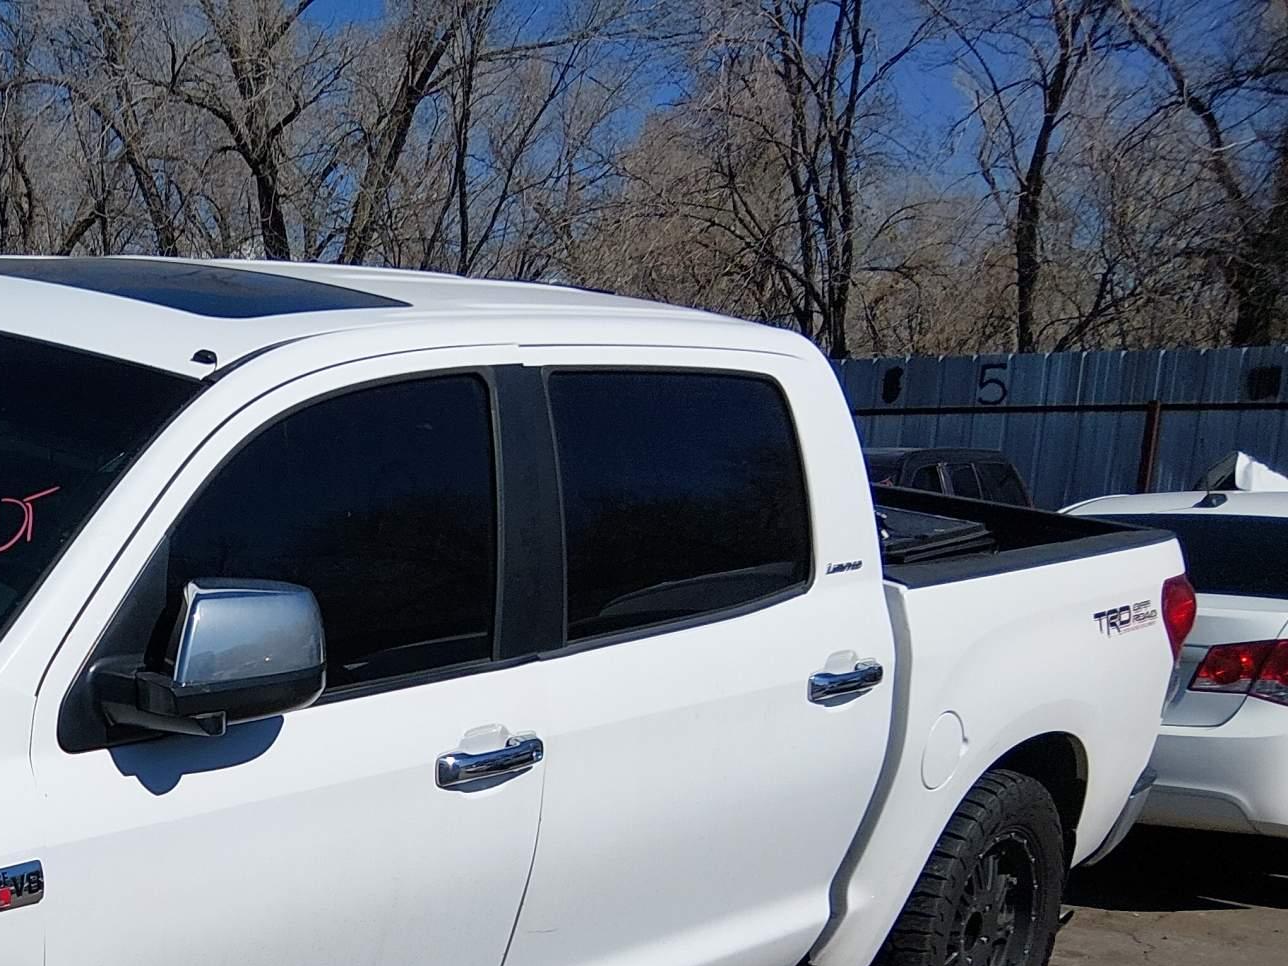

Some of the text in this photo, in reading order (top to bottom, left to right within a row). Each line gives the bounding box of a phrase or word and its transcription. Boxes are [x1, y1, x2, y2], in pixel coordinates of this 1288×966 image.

[978, 363, 1007, 405] 5
[1093, 605, 1131, 637] TRD
[11, 870, 42, 898] V8
